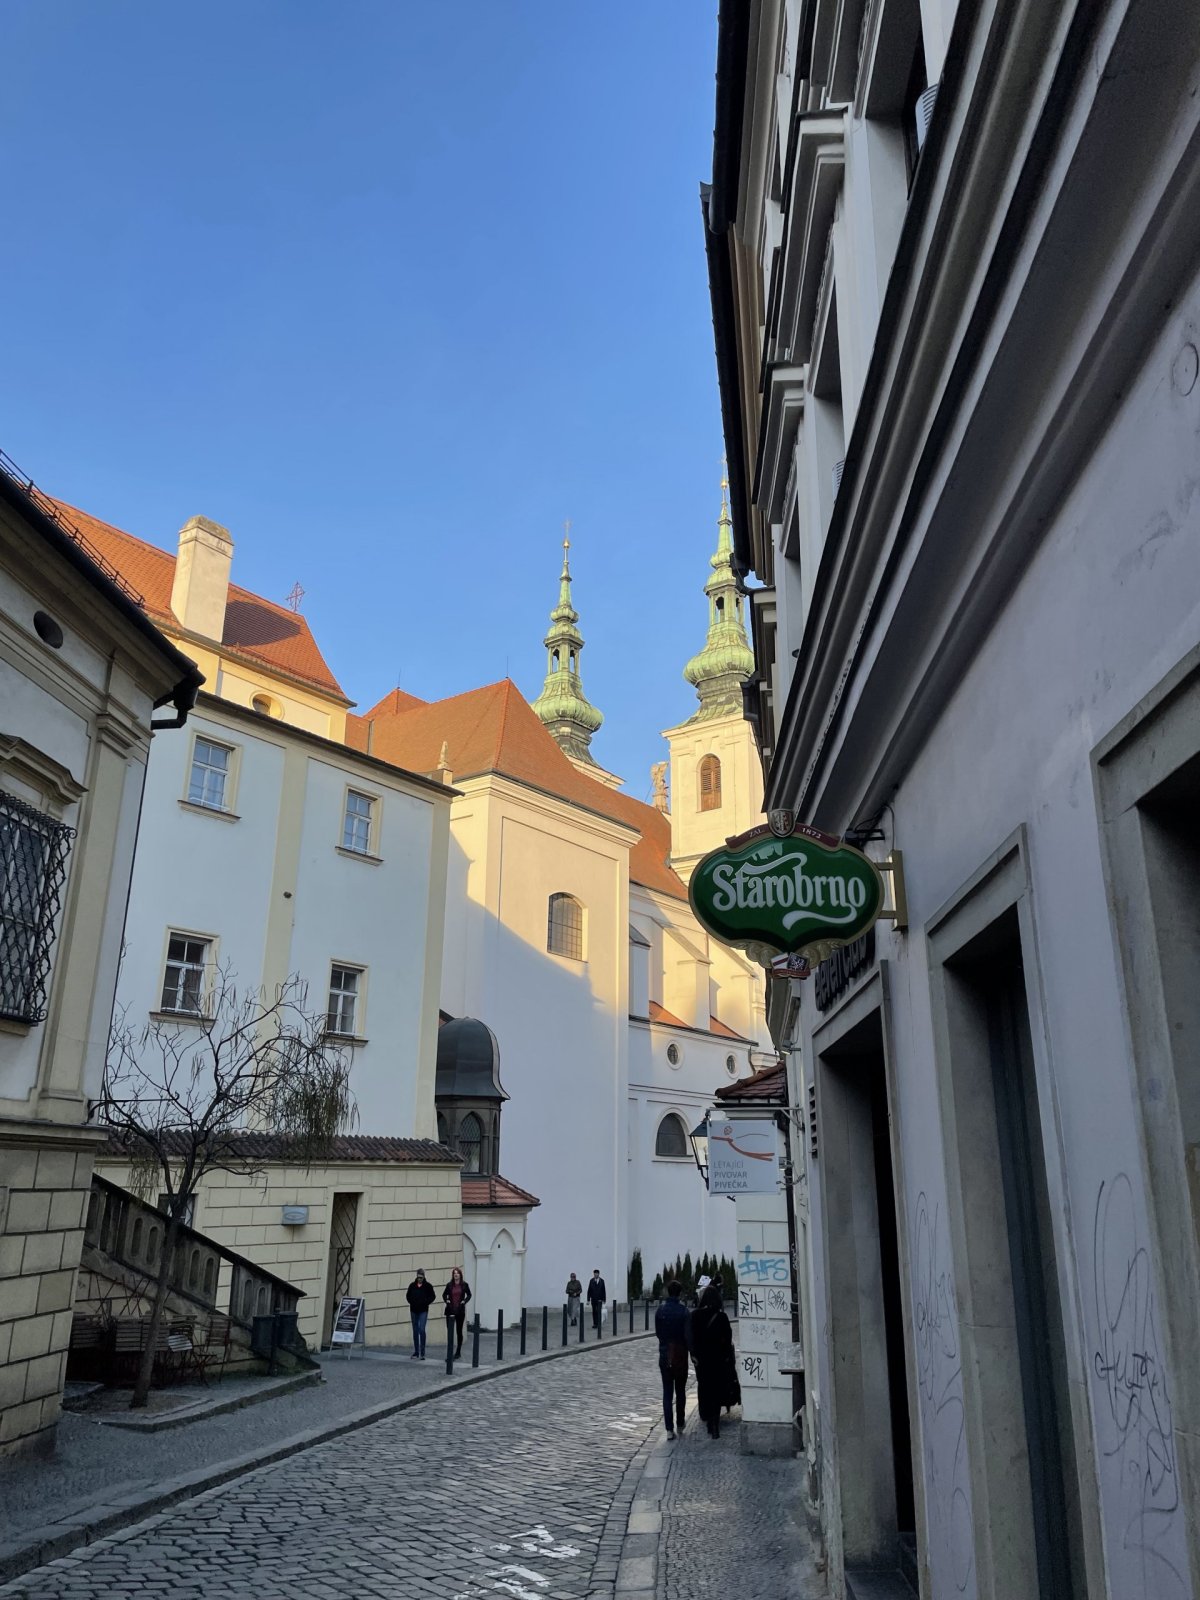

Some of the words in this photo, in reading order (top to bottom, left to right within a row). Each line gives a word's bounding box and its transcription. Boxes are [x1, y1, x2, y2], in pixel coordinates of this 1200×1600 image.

[712, 852, 867, 930] Starobrno
[714, 1171, 748, 1179] PIVOVAR
[714, 1180, 748, 1188] PIVEČKA
